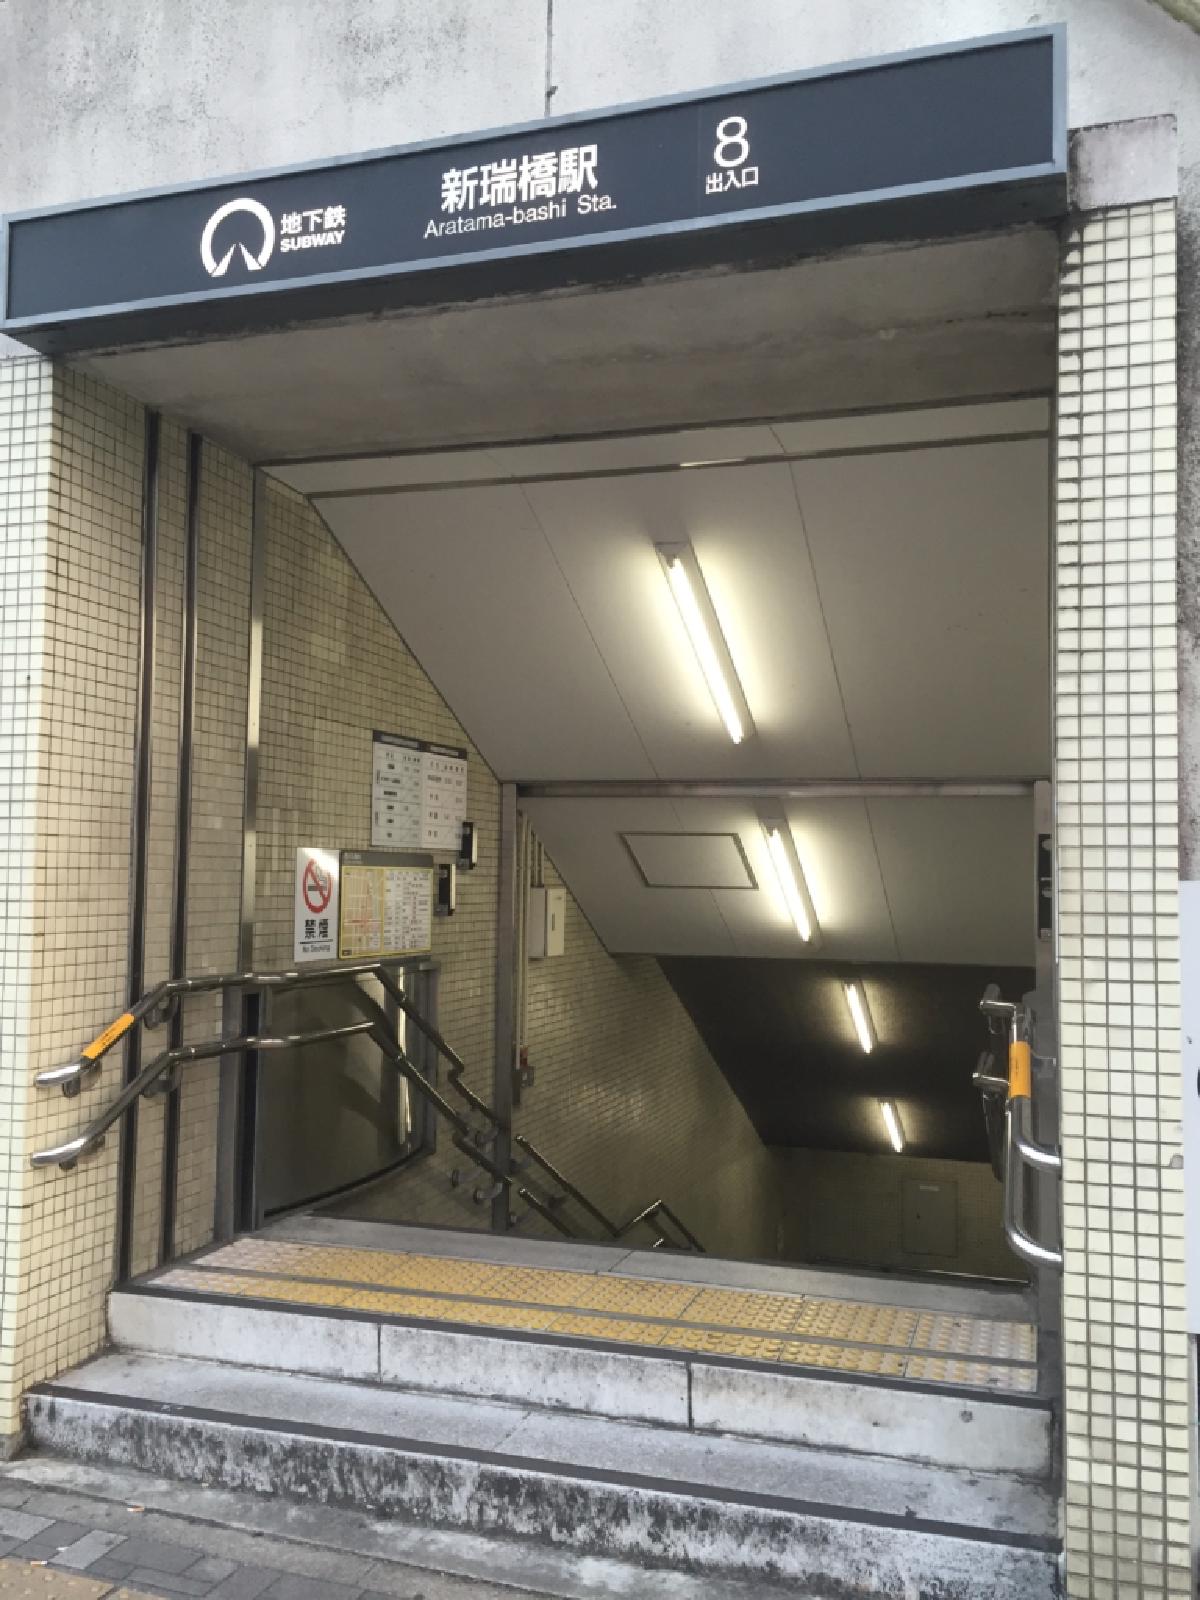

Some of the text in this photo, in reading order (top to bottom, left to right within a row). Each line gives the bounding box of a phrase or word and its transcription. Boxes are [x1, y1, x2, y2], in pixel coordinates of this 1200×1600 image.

[714, 115, 750, 168] 8
[441, 144, 599, 214] 新瑞橋駅
[705, 166, 759, 195] 出入口
[280, 205, 347, 235] 地下鉄
[422, 193, 617, 239] Aratama-bashi Sta.
[280, 230, 346, 253] SUBWAY
